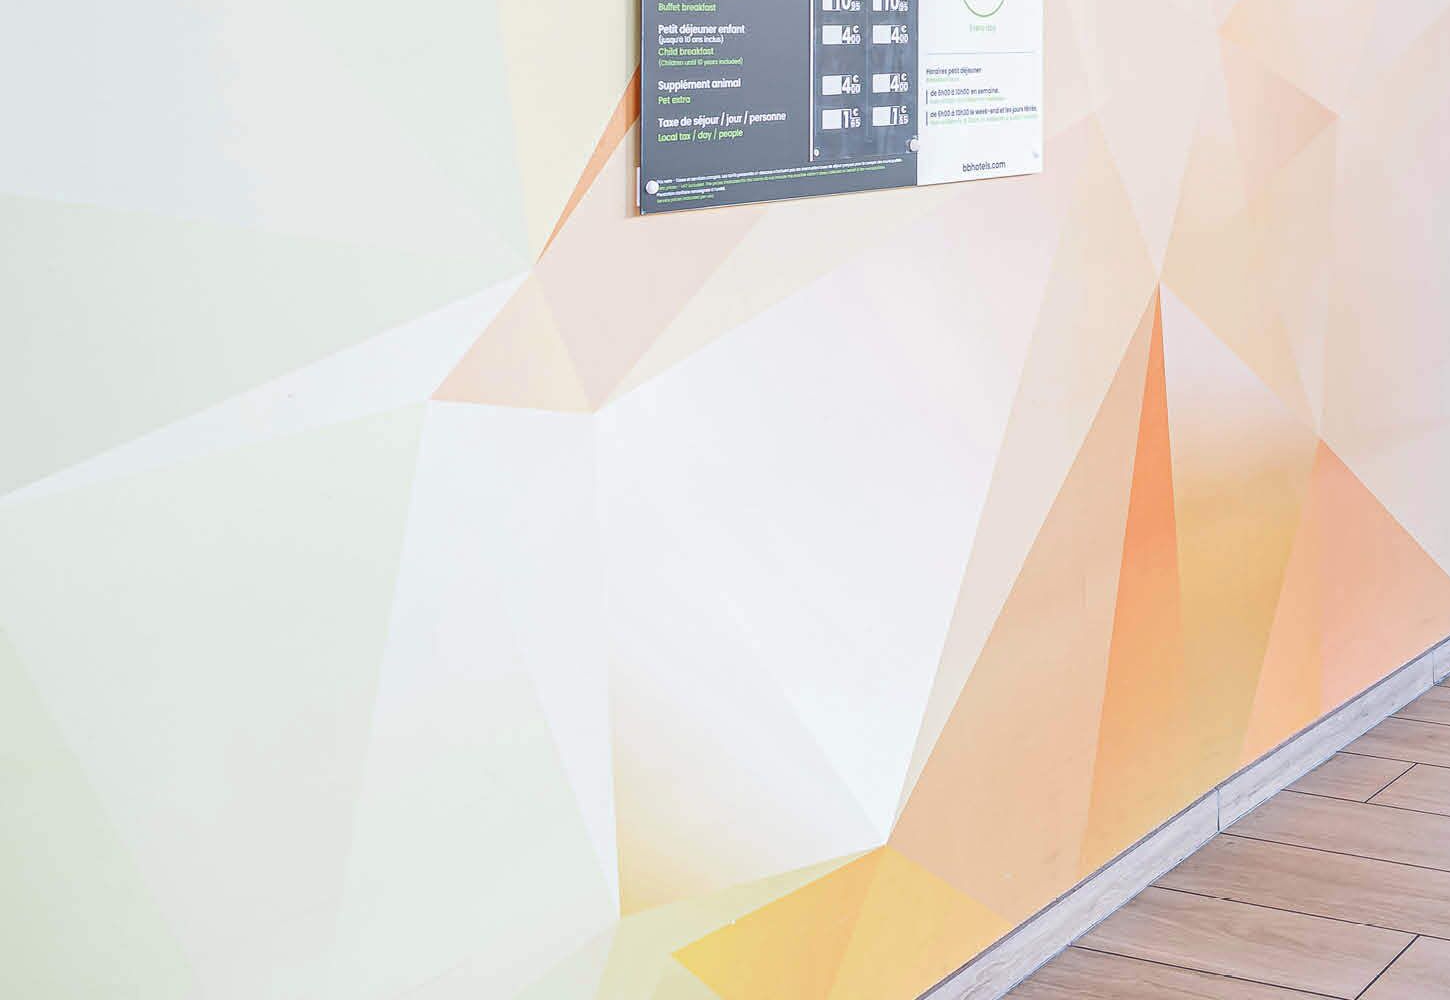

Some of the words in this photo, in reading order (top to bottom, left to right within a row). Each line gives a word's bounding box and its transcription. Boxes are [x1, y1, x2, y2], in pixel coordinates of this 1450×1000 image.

[658, 3, 680, 11] Buffet
[682, 3, 716, 11] breakfast
[658, 24, 678, 34] Petit
[679, 24, 717, 36] déjeuner
[718, 24, 745, 33] enfant
[680, 47, 714, 55] breakfast
[658, 79, 710, 92] Supplément
[712, 78, 741, 88] animal
[658, 96, 670, 104] Pet
[672, 96, 690, 104] extra
[658, 118, 679, 128] Taxe
[681, 116, 691, 126] de
[694, 116, 720, 128] séjour
[720, 112, 725, 126] /
[726, 115, 742, 126] jour
[744, 111, 748, 124] /
[749, 112, 786, 124] personne
[658, 134, 678, 142] Local
[692, 130, 696, 141] /
[698, 131, 712, 140] day
[714, 128, 717, 139] /
[719, 129, 743, 139] people
[962, 161, 1006, 172] bbhotels.com
